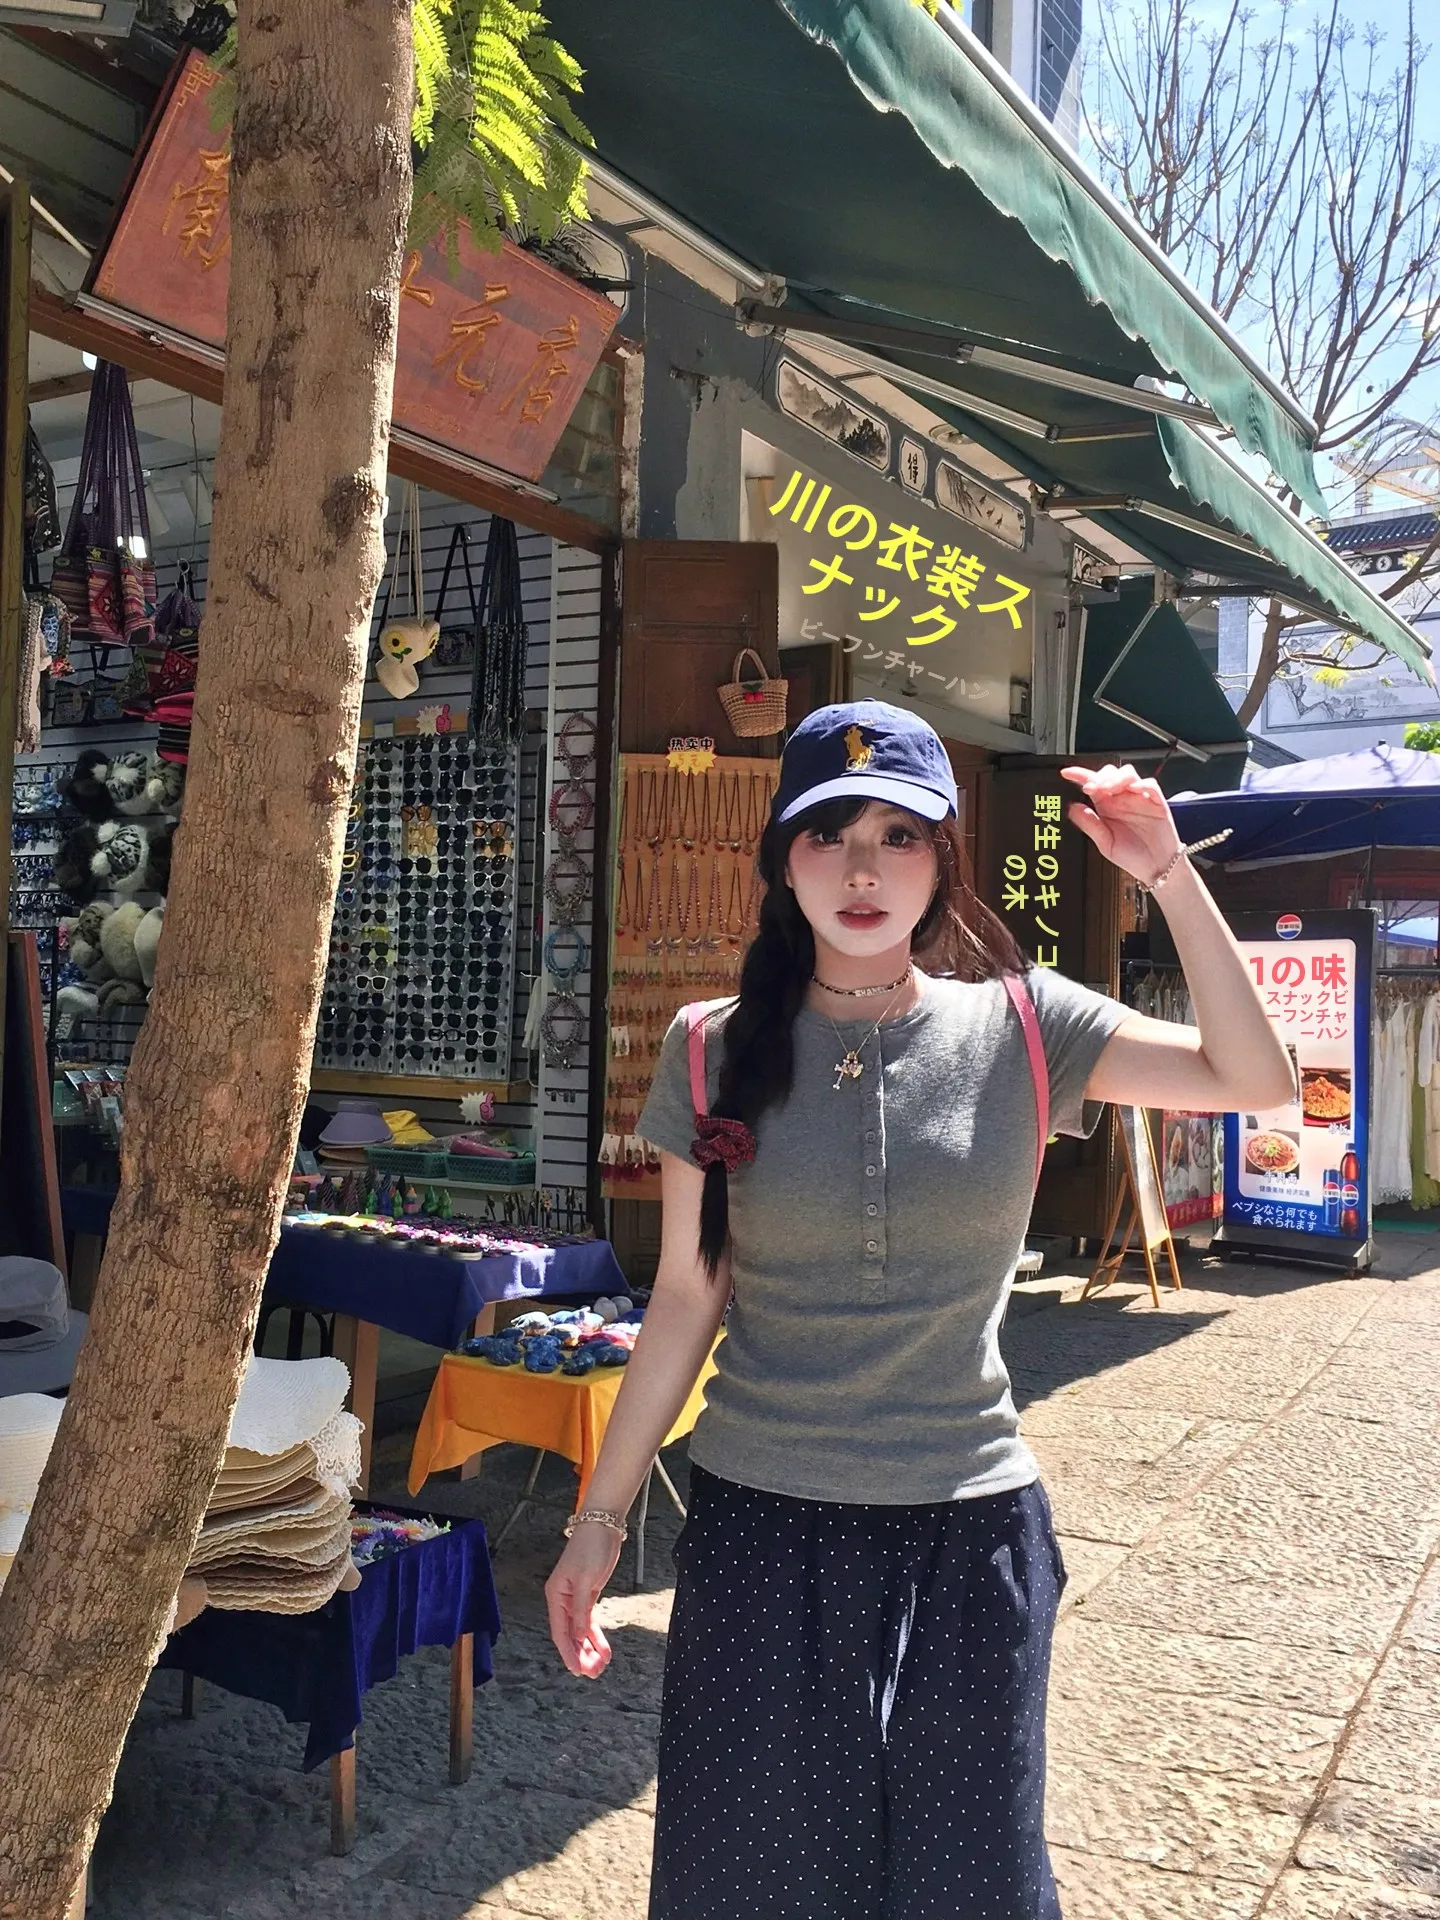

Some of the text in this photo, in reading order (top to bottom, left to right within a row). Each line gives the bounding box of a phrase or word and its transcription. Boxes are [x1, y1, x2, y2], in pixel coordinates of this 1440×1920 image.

[769, 470, 1031, 630] 川の衣装ス
[801, 554, 957, 646] ナック
[800, 618, 990, 699] ビーフンチャーハン
[670, 737, 714, 751] 热卖中
[1001, 854, 1030, 911] の木
[1033, 794, 1062, 968] 野生のキノコ
[1266, 990, 1348, 1006] スナックビ
[1266, 1008, 1347, 1024] ーフンチャ
[1300, 1027, 1347, 1040] ーハン
[1252, 1214, 1317, 1231] 食べられます
